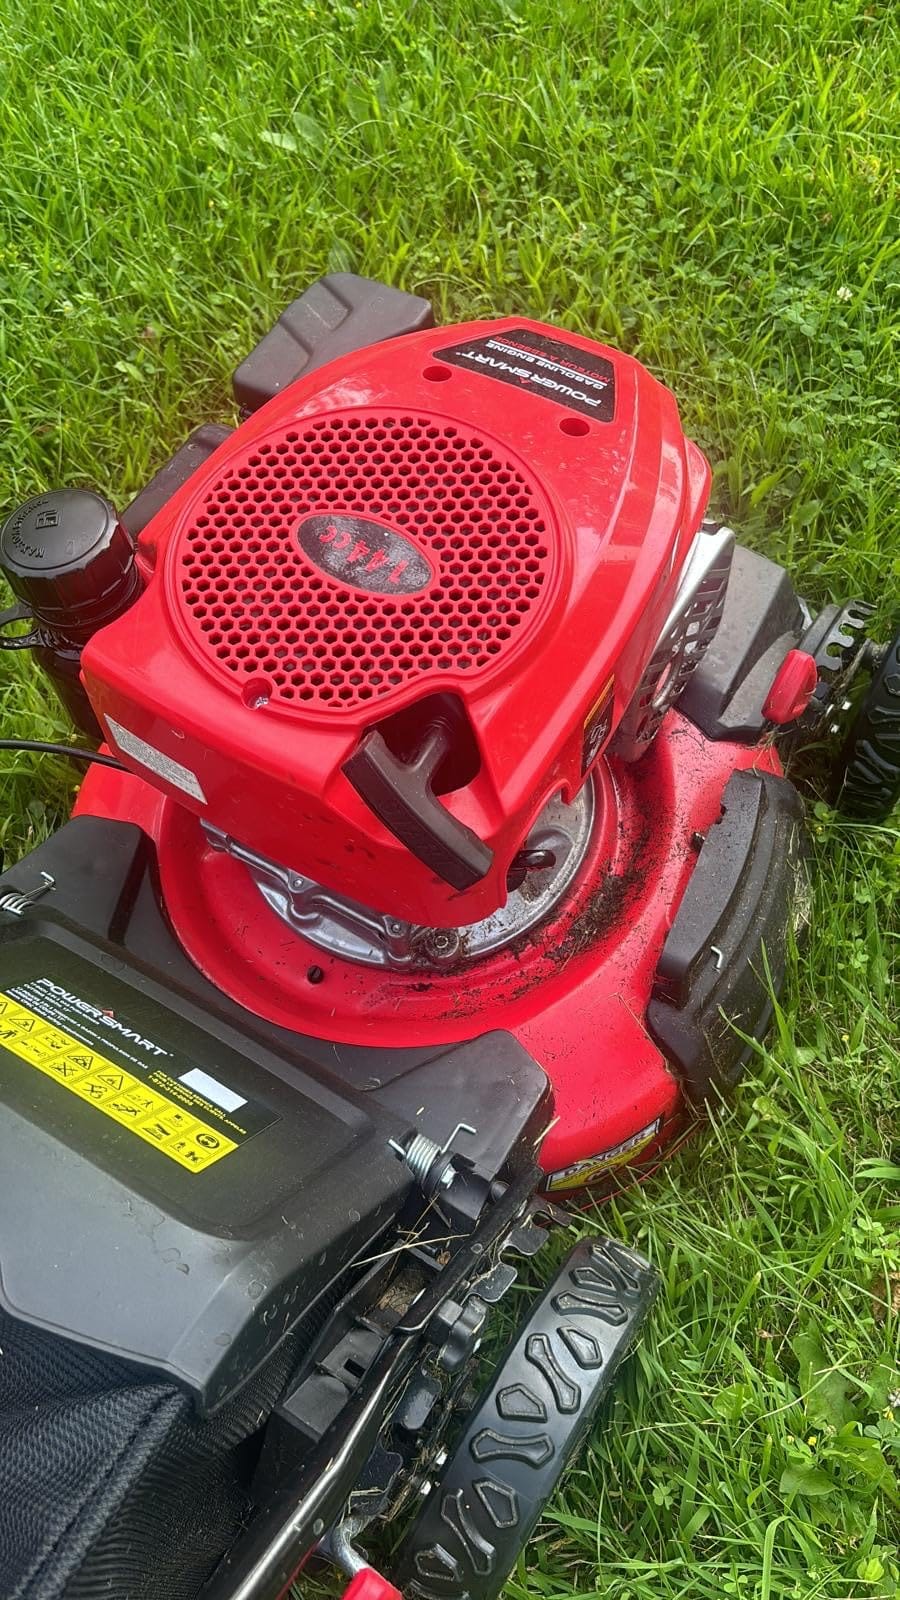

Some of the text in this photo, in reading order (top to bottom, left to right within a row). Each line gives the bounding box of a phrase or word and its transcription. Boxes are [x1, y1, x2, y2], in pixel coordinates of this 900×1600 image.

[485, 341, 605, 390] GASOLINE ENGINE
[560, 358, 611, 384] MOTEUR
[36, 977, 168, 1056] POWERSMART
